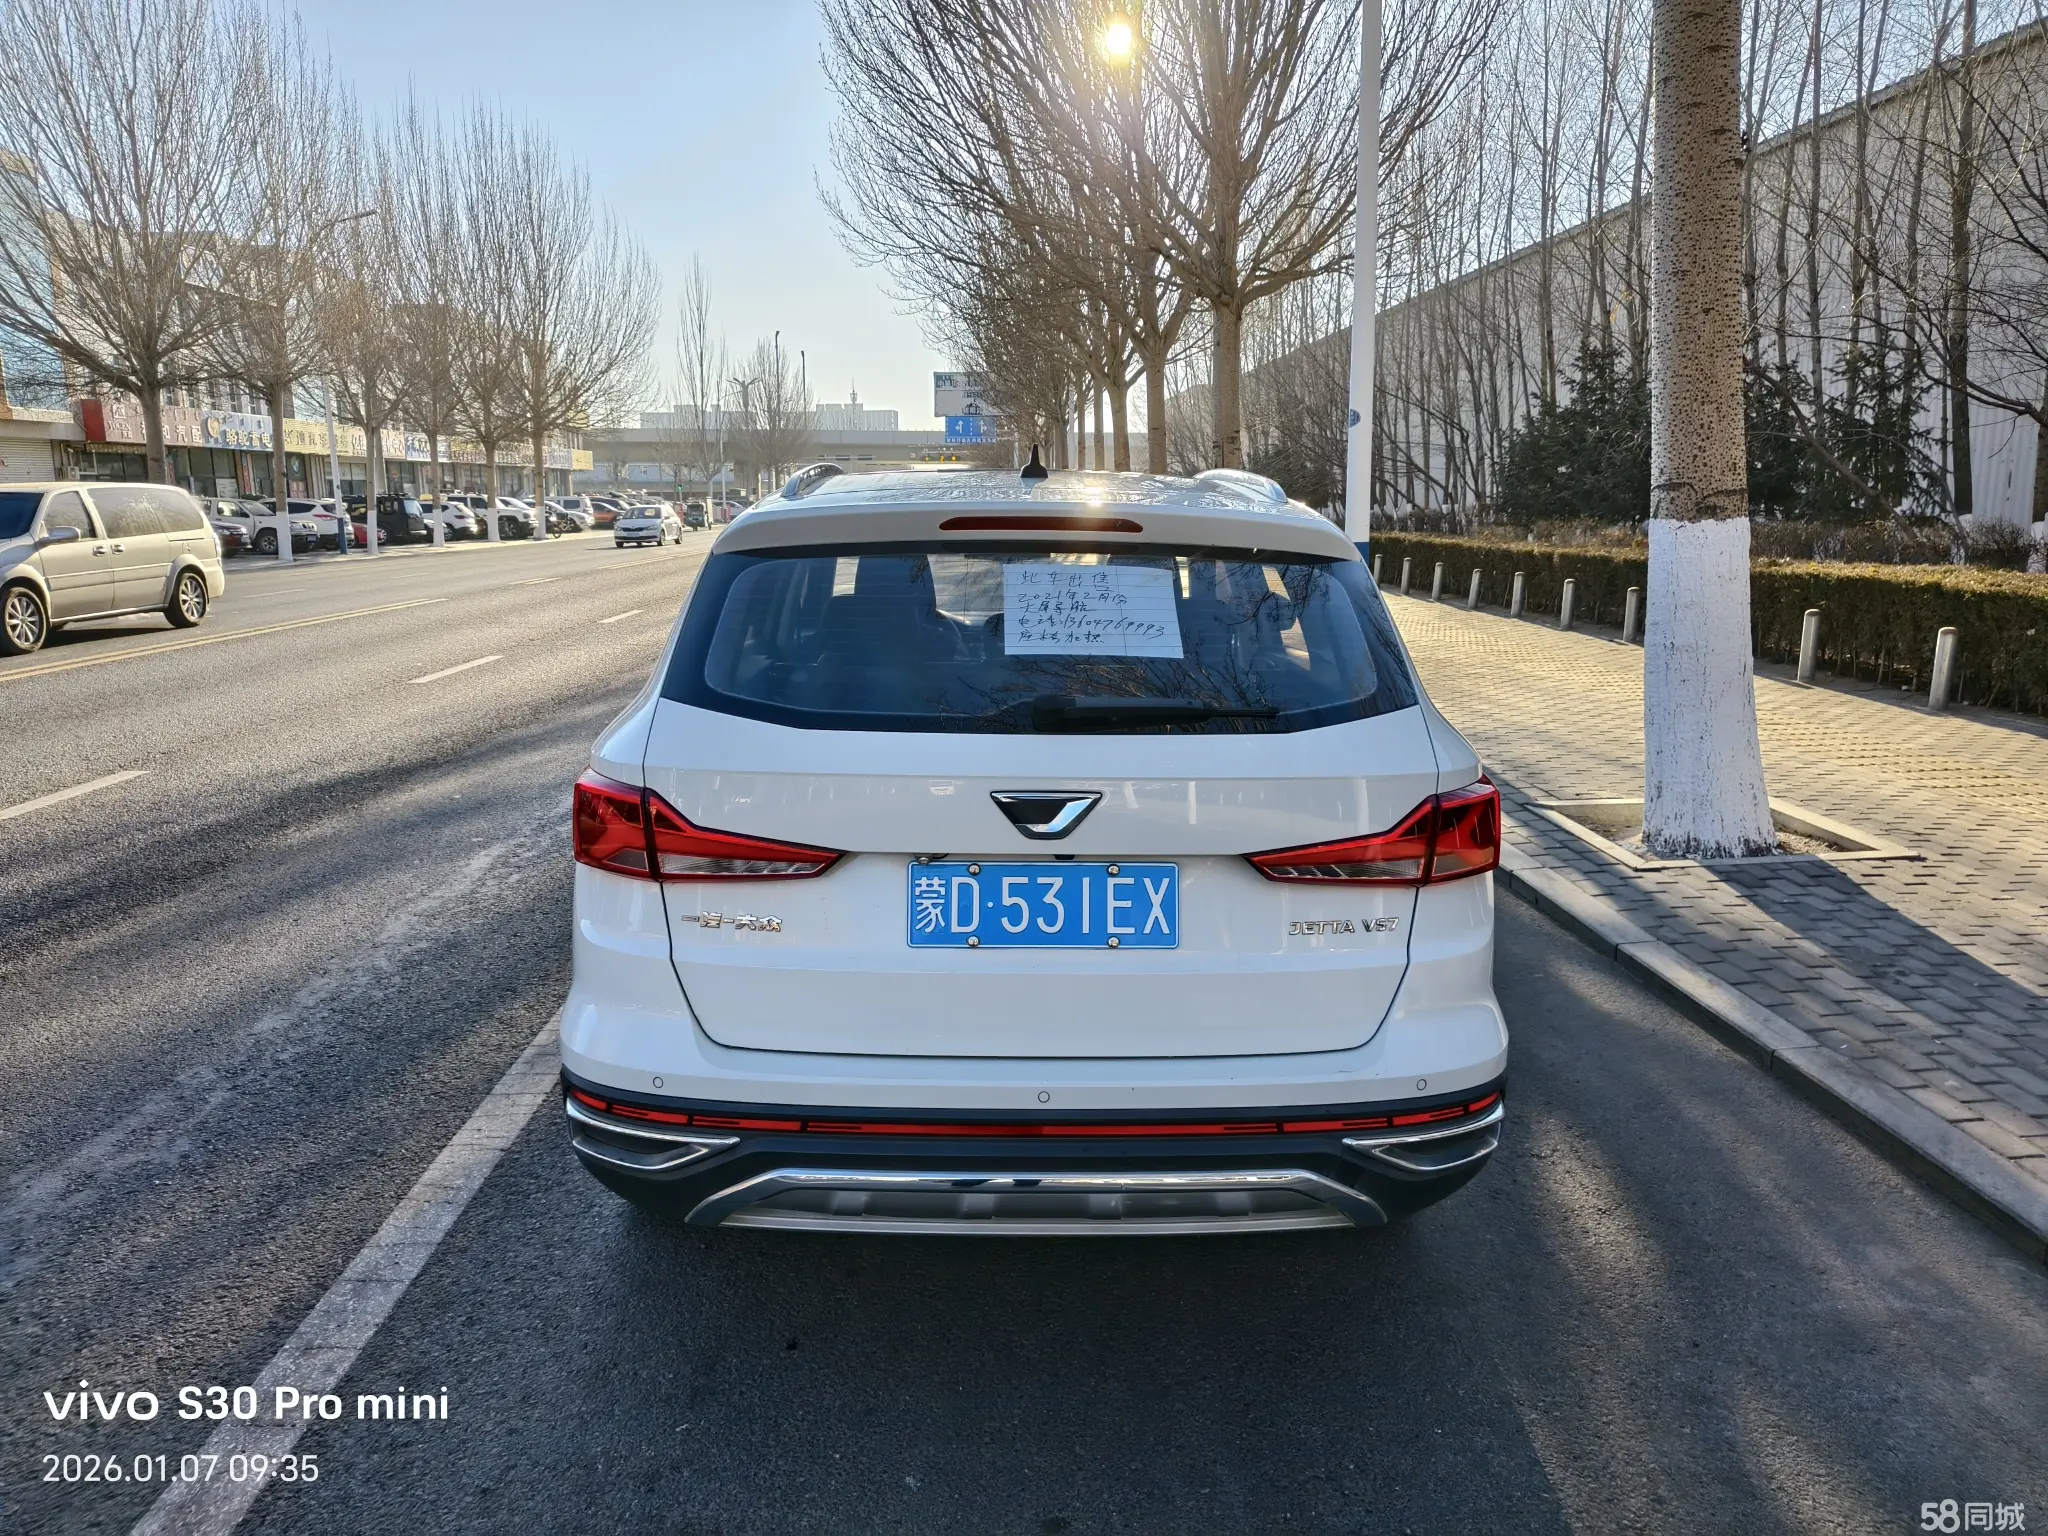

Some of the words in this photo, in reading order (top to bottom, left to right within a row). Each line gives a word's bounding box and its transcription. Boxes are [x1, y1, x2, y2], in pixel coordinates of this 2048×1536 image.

[1021, 570, 1114, 592] 此车出售
[1018, 589, 1128, 605] 2021年2月份
[1023, 601, 1090, 615] 大屏导航
[914, 876, 1171, 934] 蒙D·531EX
[681, 911, 782, 932] 一汽-大众
[1289, 920, 1355, 935] JETTA
[1362, 917, 1399, 933] VS7
